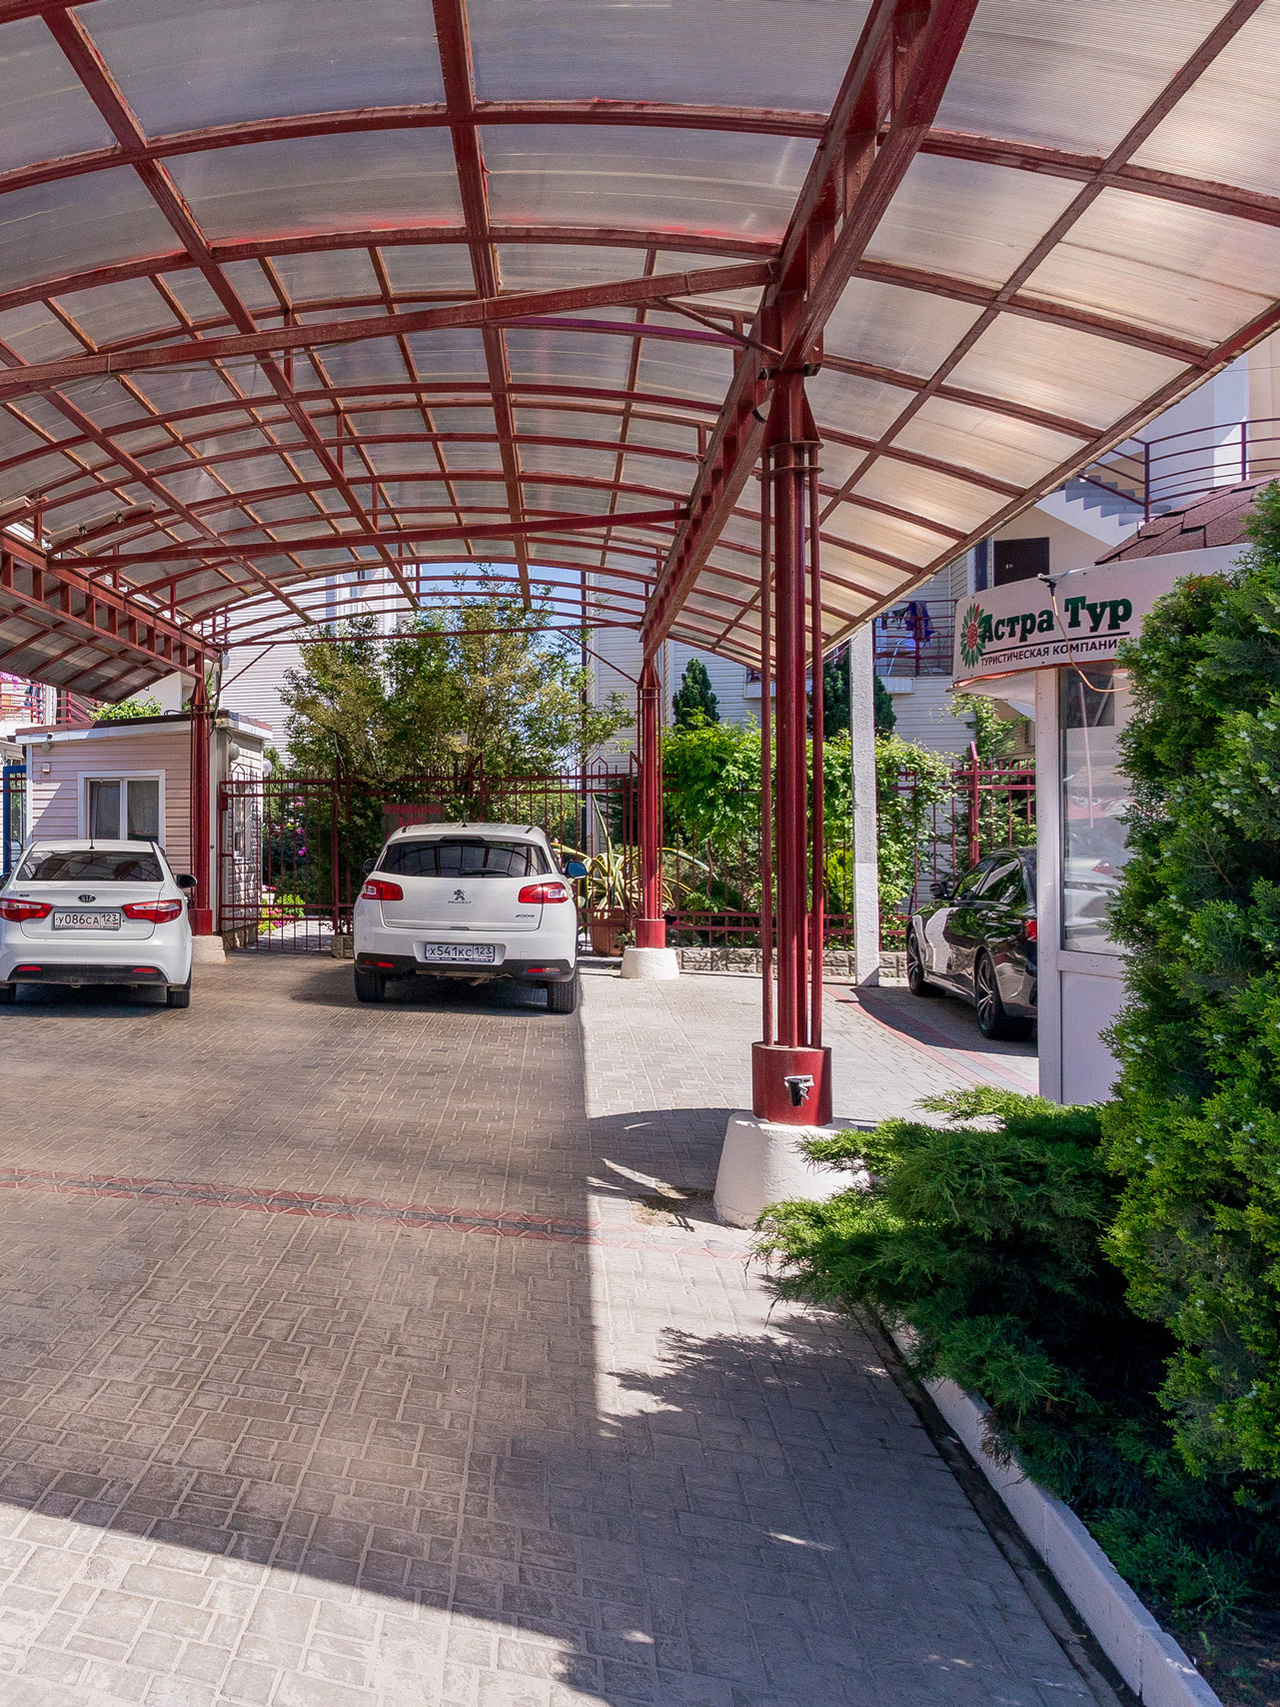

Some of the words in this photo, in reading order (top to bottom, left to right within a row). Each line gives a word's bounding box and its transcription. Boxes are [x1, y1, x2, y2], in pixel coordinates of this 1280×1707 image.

[983, 608, 1054, 642] Астра
[1064, 595, 1132, 632] Тур
[980, 647, 1049, 667] ТУРИСТИЧЕСКАЯ
[1053, 638, 1125, 654] КОМПАНИ
